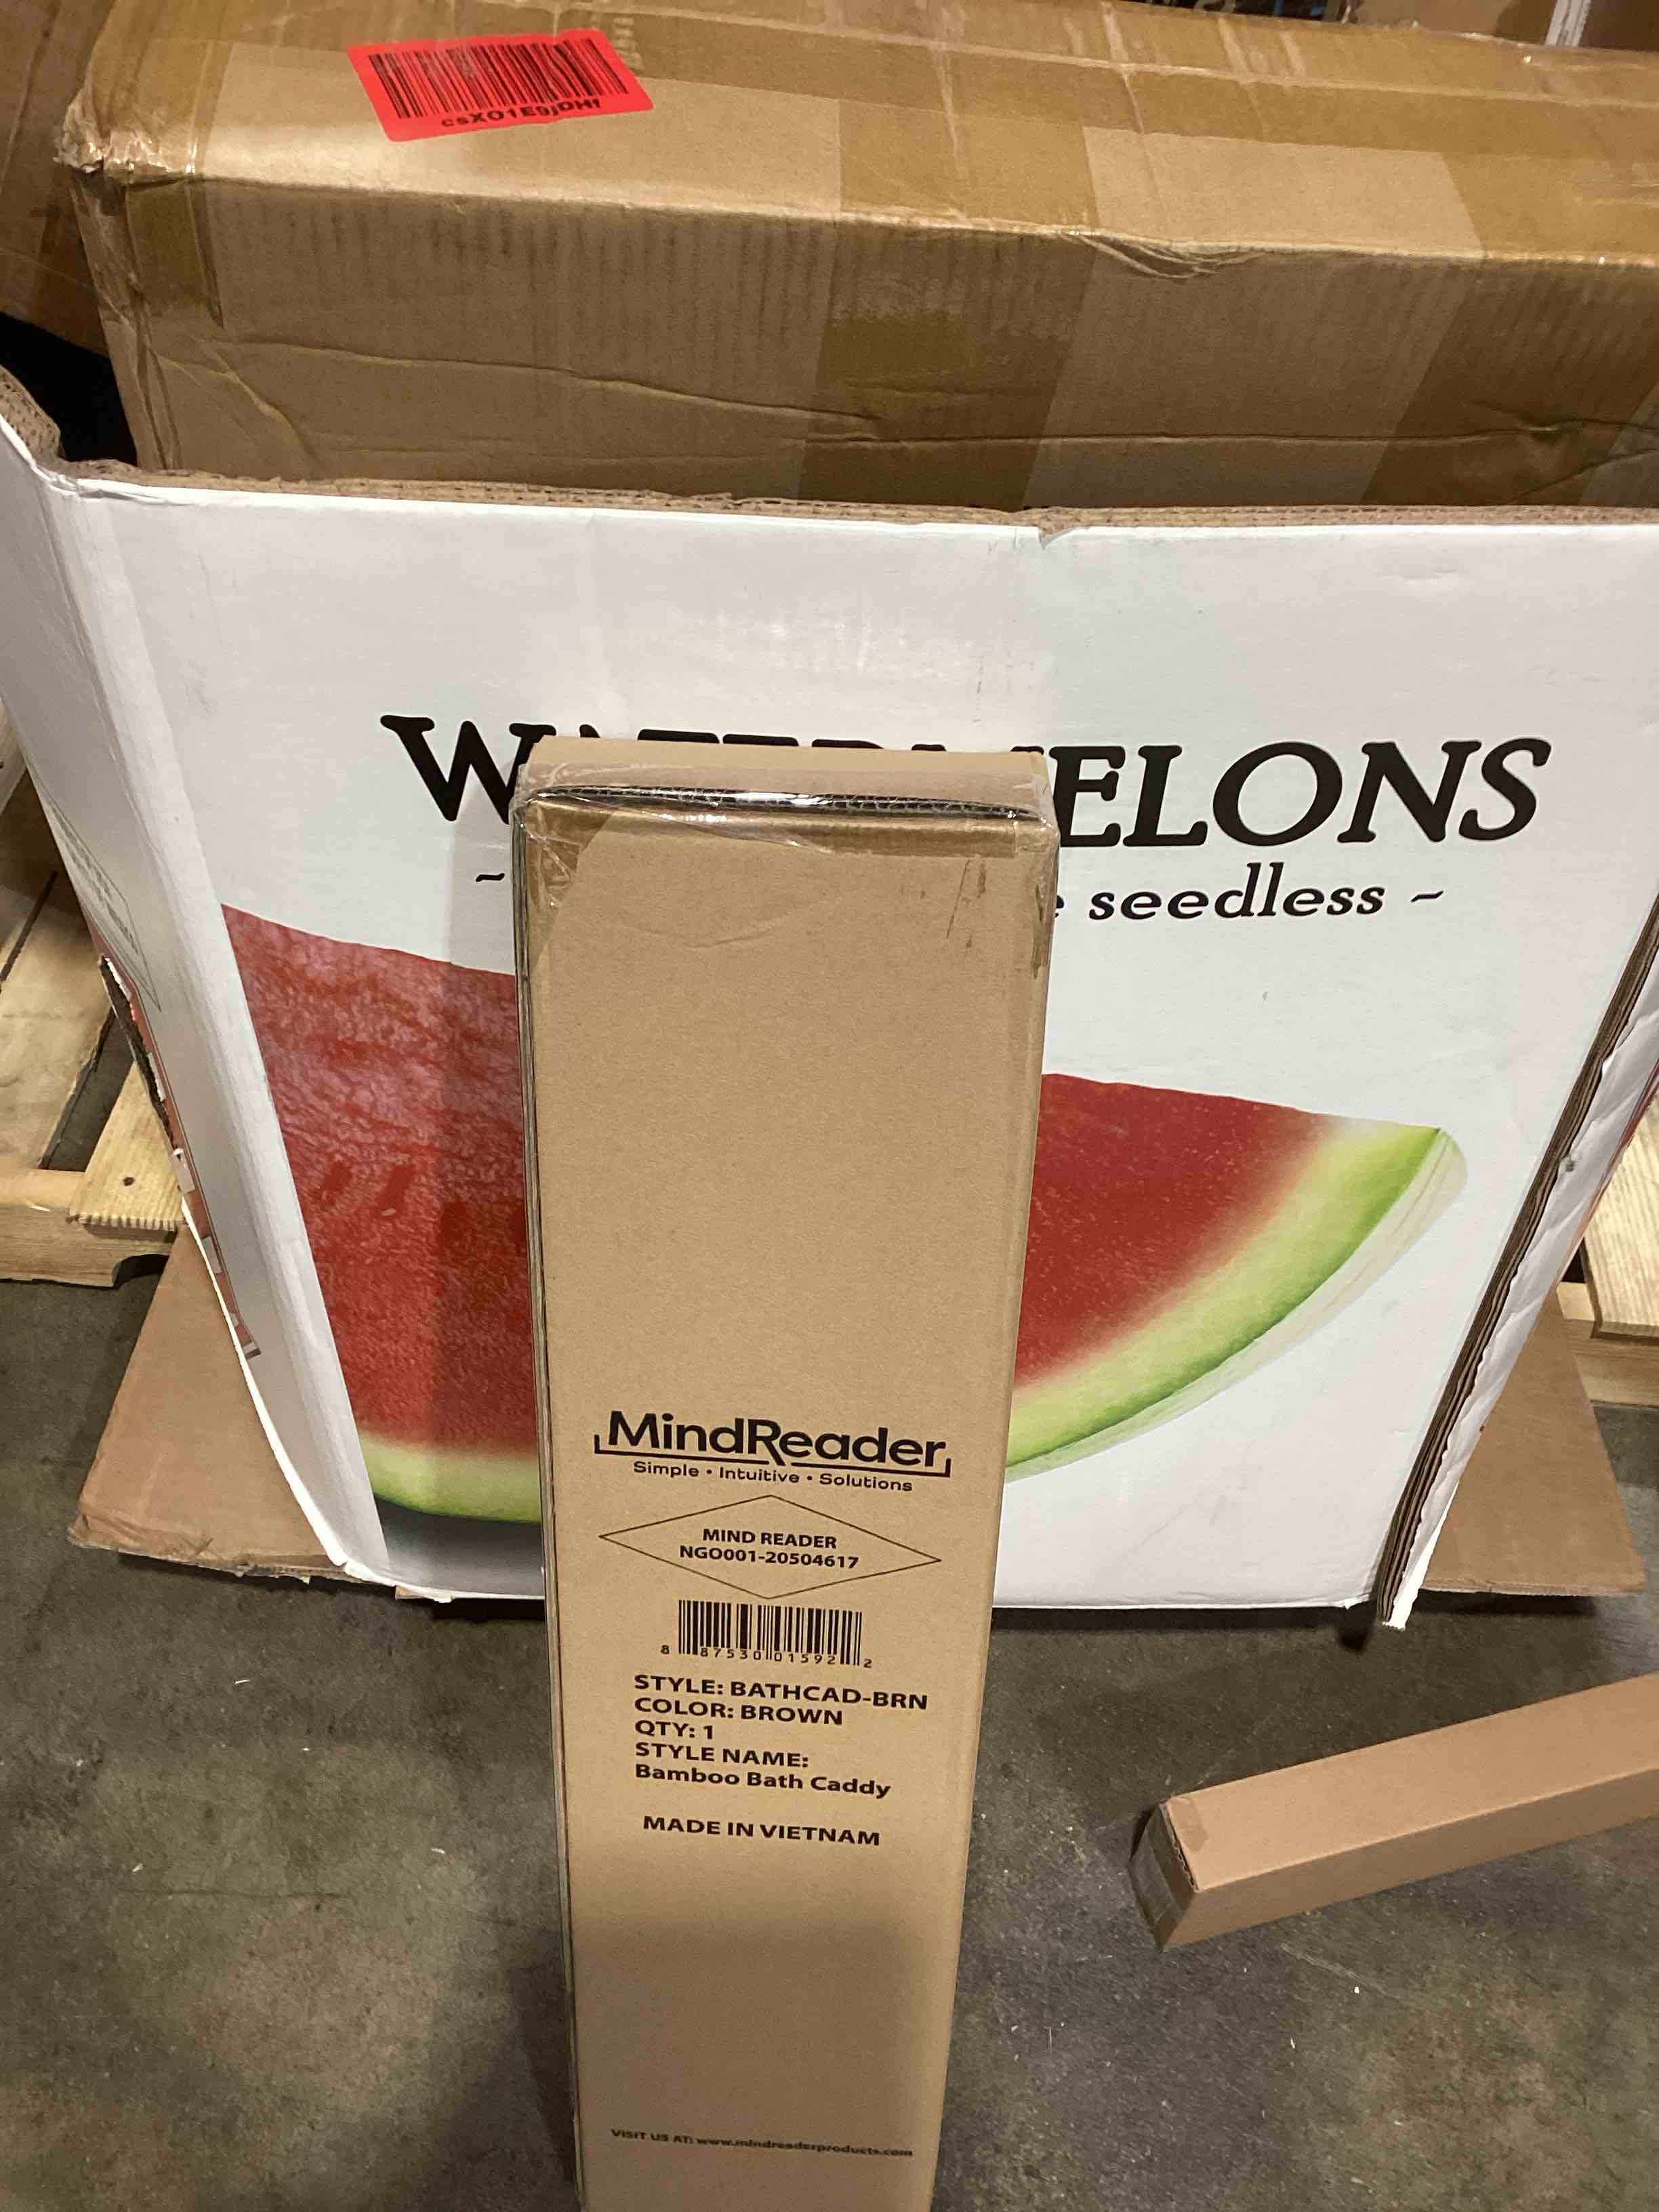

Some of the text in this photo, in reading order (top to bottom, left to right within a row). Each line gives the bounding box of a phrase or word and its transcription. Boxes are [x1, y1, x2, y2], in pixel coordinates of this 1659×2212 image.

[381, 714, 1552, 848] WELONS
[1088, 862, 1386, 920] seedless
[608, 1410, 946, 1467] MindReader
[634, 1460, 913, 1492] Simple Intuitive Solutions
[703, 1528, 837, 1549] MIND READER
[634, 1675, 928, 1710] STYLE: BATHCAD-BRN
[634, 1698, 843, 1725] COLOR: BROWN
[635, 1720, 714, 1740] QTY: 1
[636, 1742, 809, 1767] STYLE NAME:
[636, 1764, 891, 1799] Bamboo Bath Caddy
[643, 1816, 880, 1846] MADE IN VIETNAM
[611, 2129, 913, 2157] VISIT US AT: www.mindreaderproducts.com
